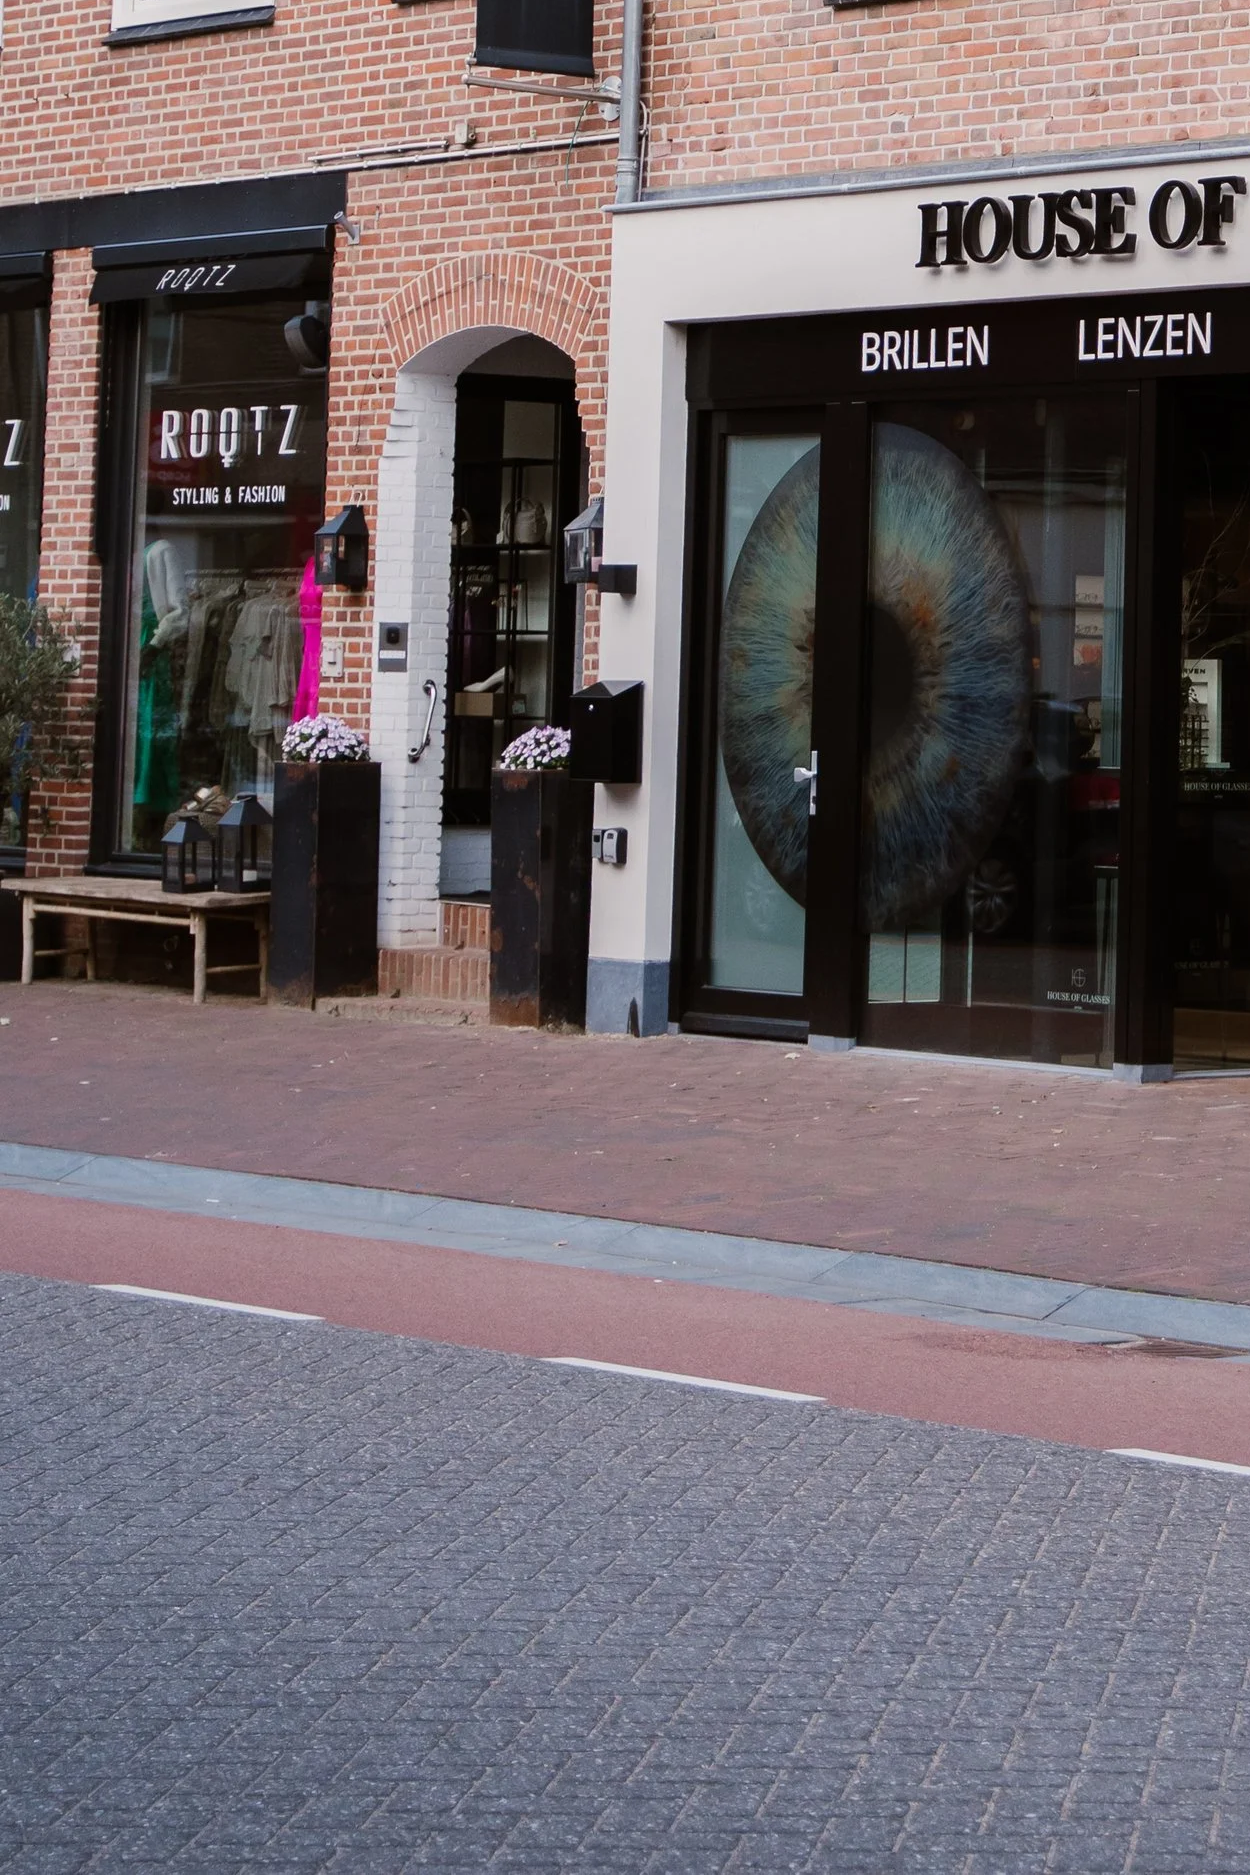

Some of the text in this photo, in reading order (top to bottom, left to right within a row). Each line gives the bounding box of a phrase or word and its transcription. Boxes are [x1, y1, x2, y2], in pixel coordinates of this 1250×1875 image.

[915, 185, 1137, 268] HOUSE
[1148, 174, 1247, 249] OF
[860, 324, 990, 373] BRILLEN
[1077, 311, 1213, 362] LENZEN
[172, 485, 286, 506] STYLING & FASHION
[1184, 781, 1209, 792] HOUSE
[1047, 990, 1111, 1005] HOUSE OF GLASSES
